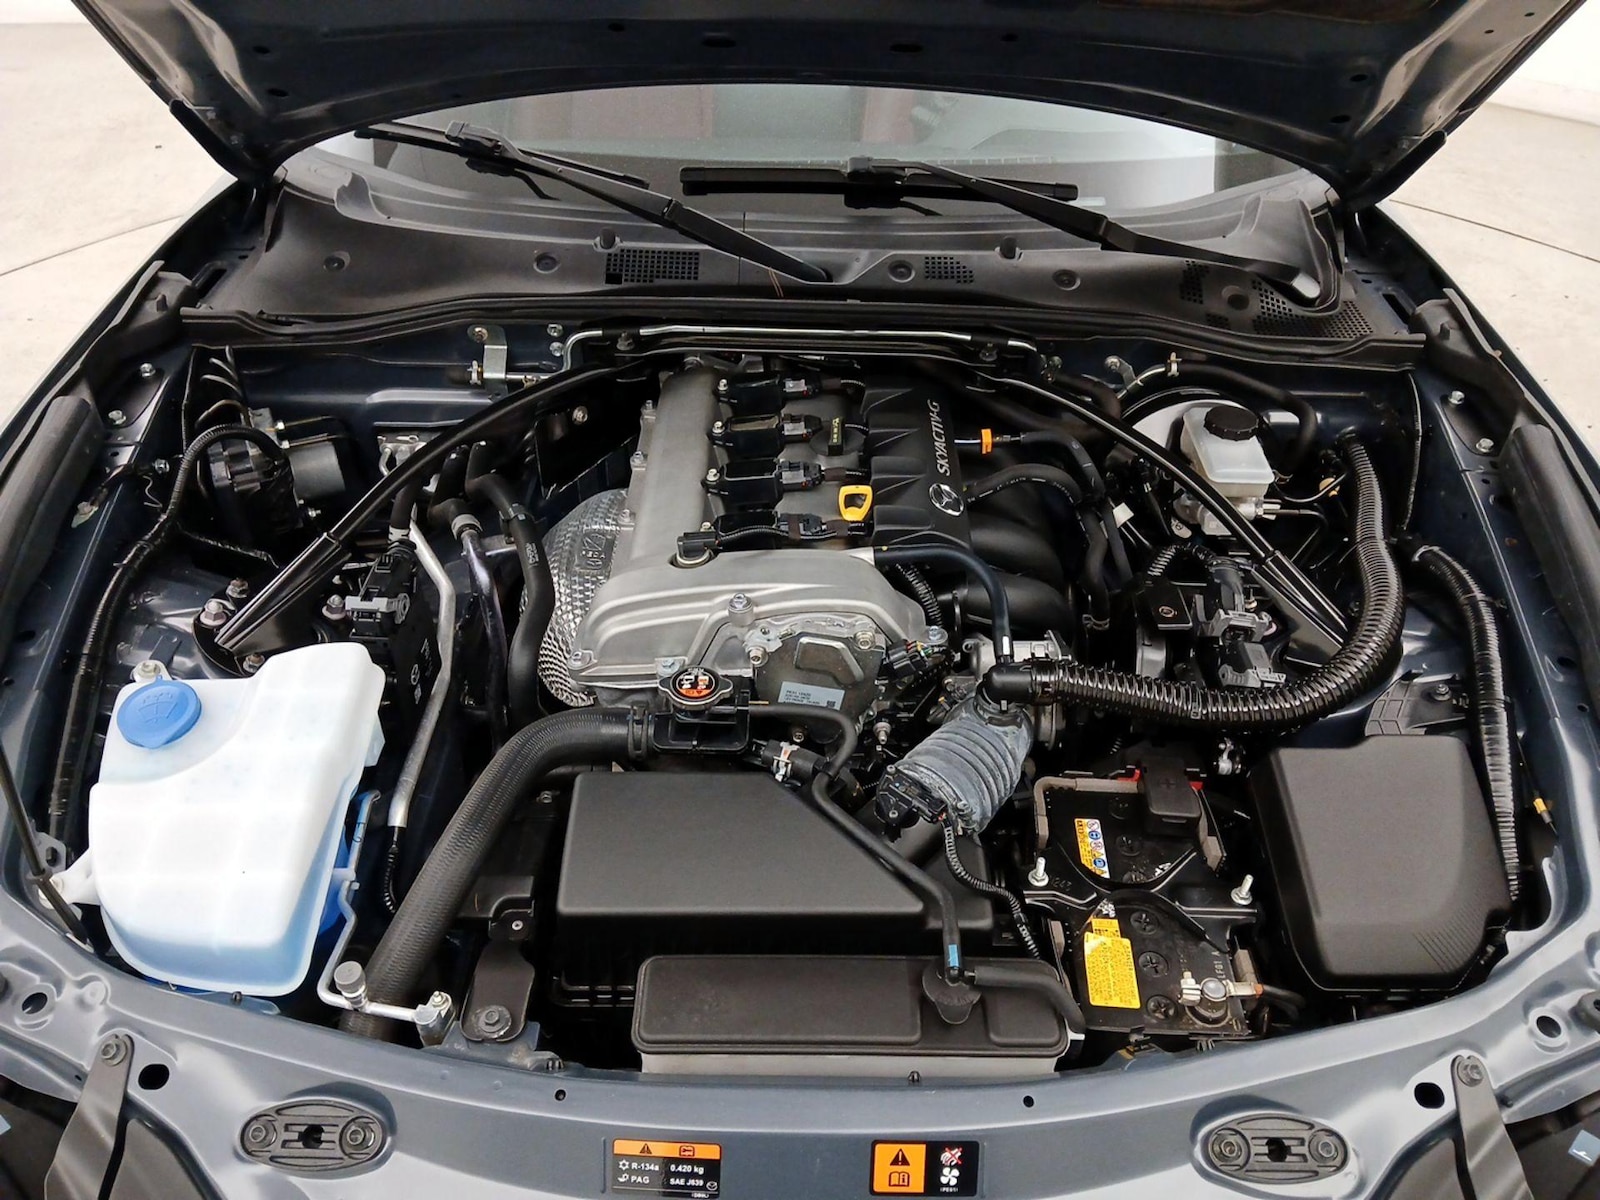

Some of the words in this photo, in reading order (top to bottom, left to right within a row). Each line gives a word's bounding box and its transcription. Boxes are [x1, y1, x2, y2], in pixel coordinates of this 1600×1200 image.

[927, 399, 950, 476] SKYACTIV-G
[631, 1162, 659, 1171] R-134a
[670, 1164, 691, 1173] 0.420
[693, 1165, 704, 1175] kg
[631, 1175, 650, 1184] PAG
[669, 1178, 685, 1186] SAE
